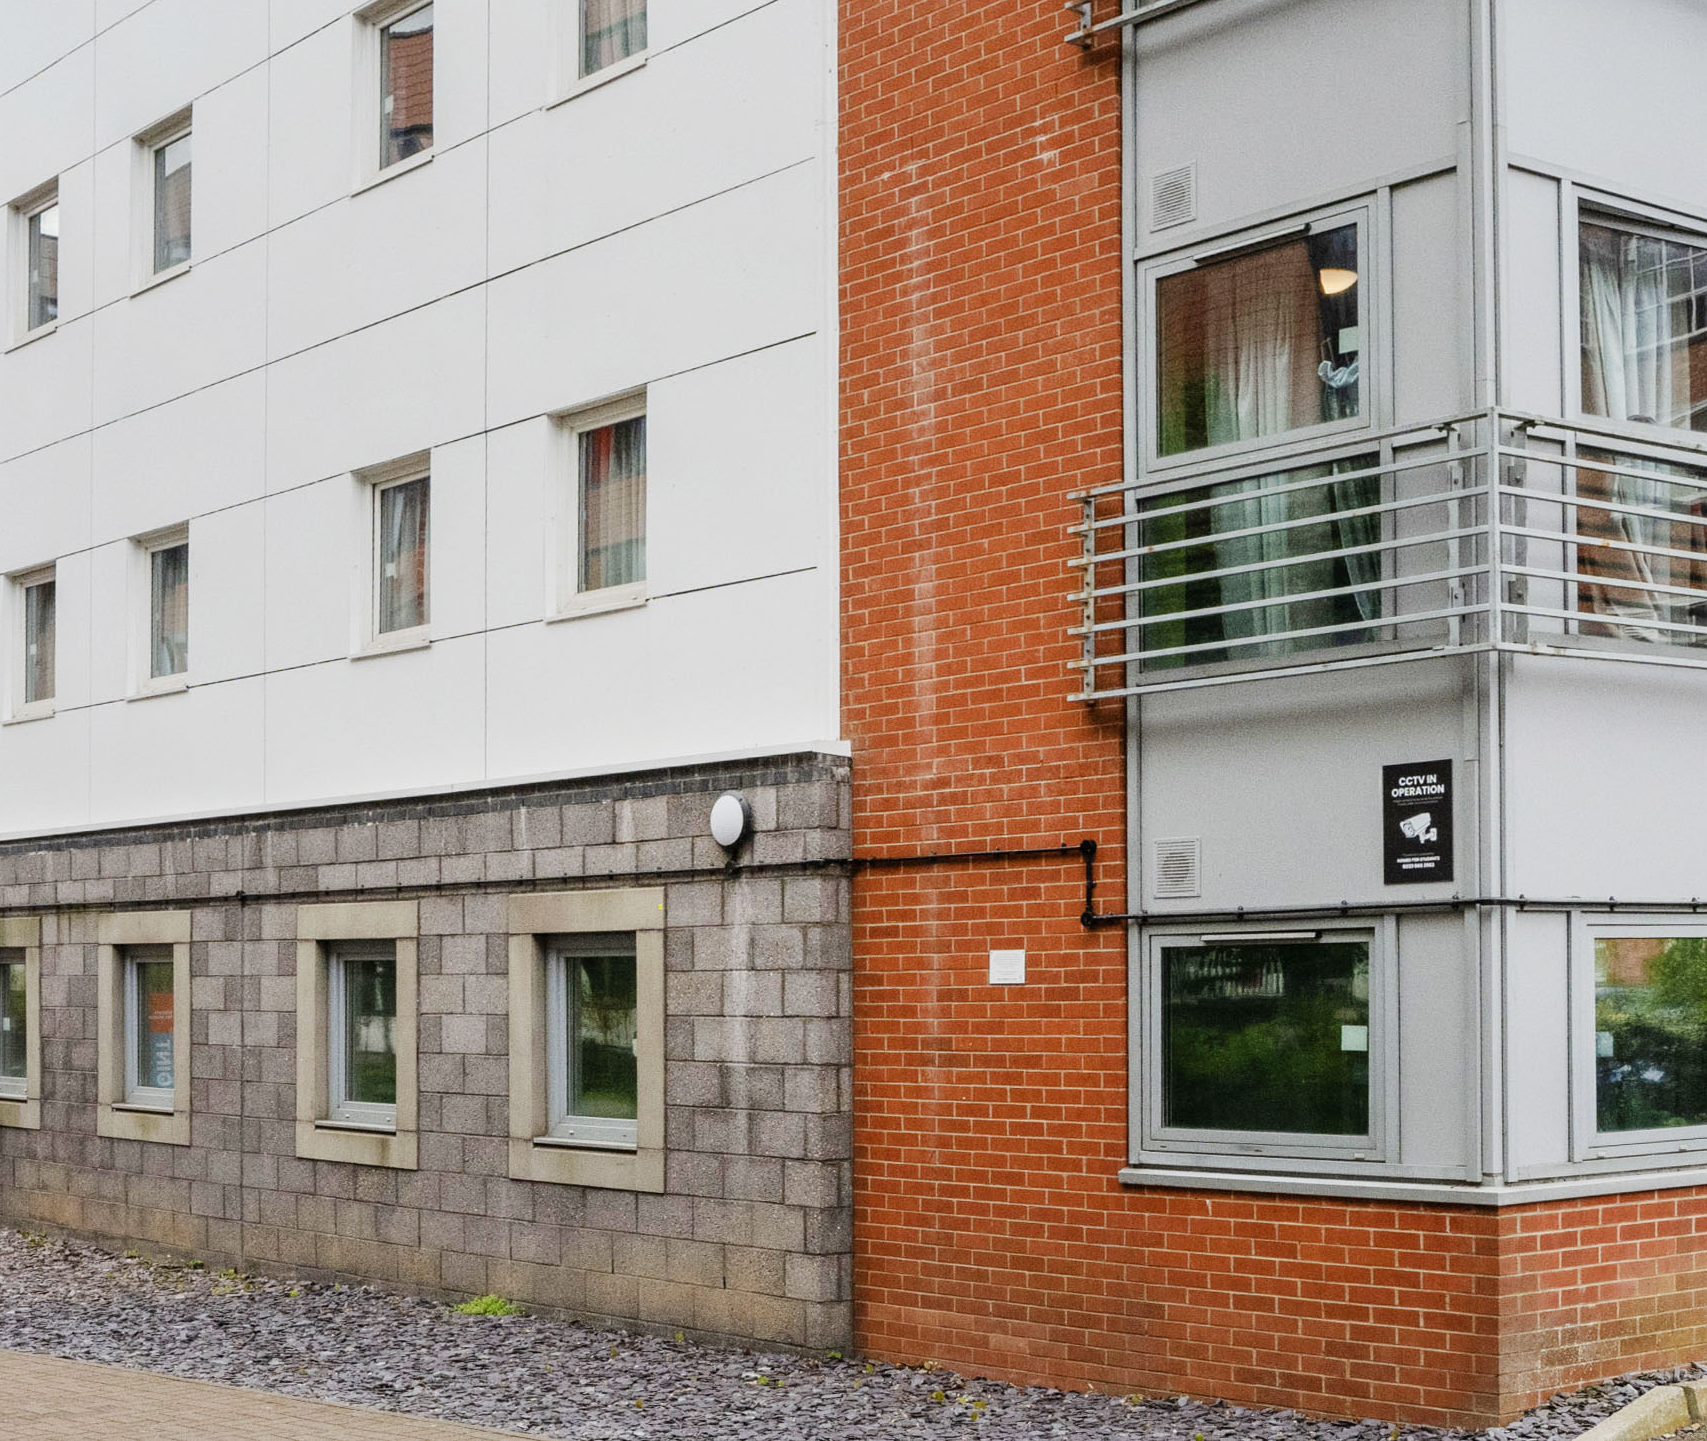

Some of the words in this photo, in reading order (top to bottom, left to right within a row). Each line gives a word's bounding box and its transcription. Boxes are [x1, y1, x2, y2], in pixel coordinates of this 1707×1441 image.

[1398, 775, 1425, 786] CCTV
[1426, 774, 1437, 784] IN
[1391, 784, 1445, 798] OPERATION
